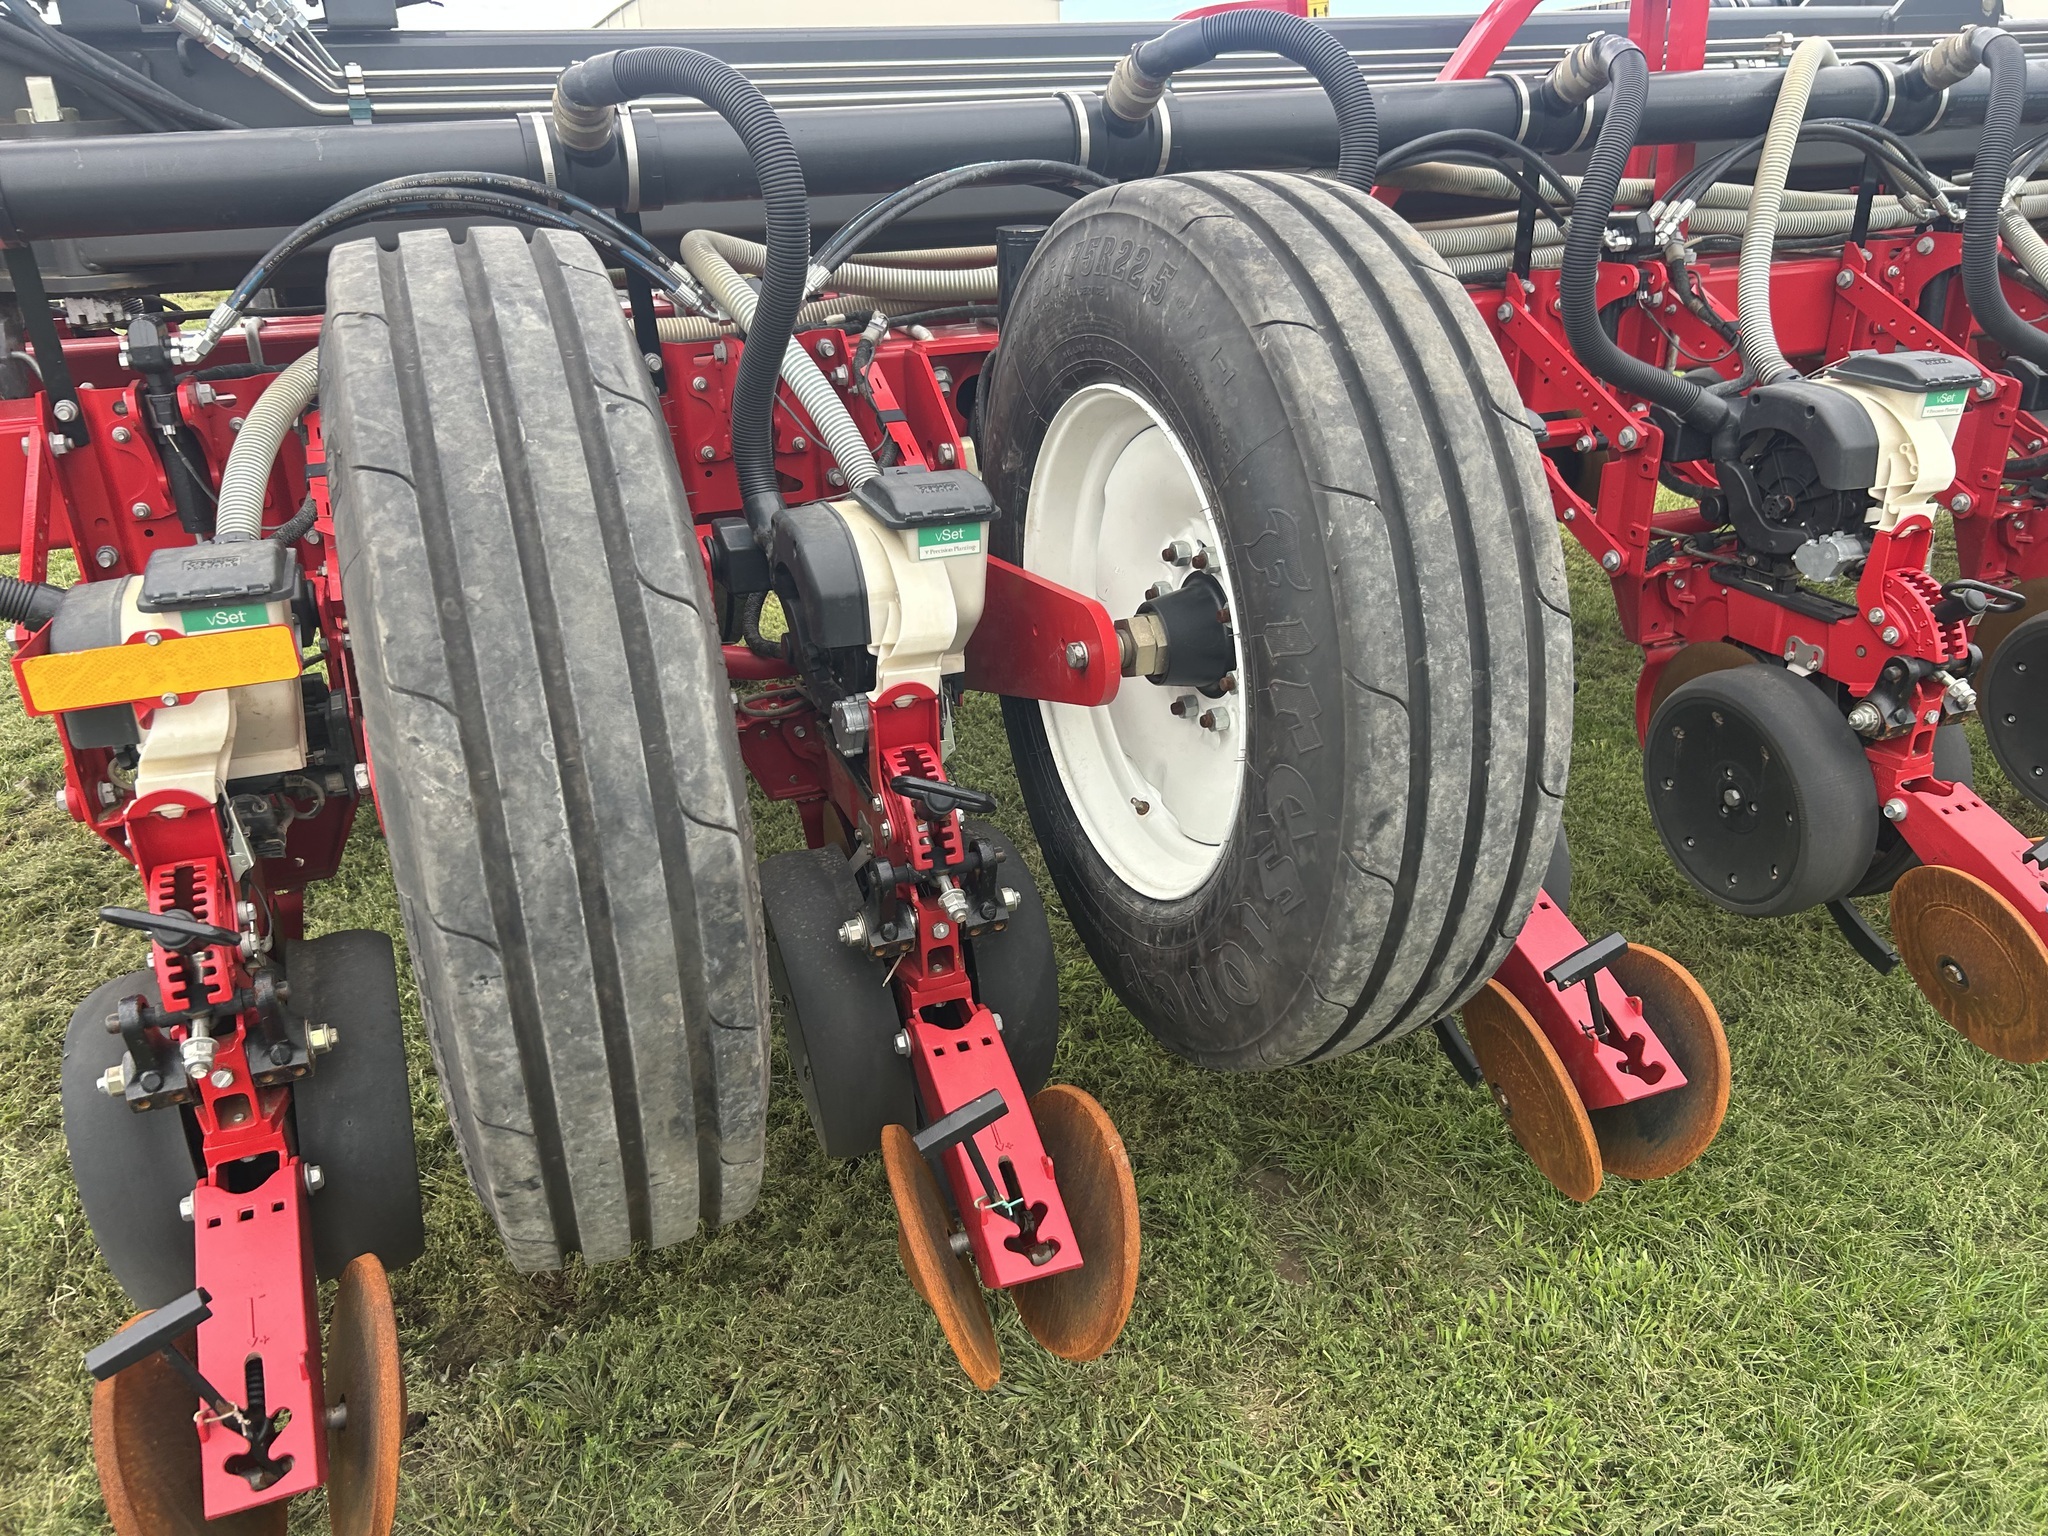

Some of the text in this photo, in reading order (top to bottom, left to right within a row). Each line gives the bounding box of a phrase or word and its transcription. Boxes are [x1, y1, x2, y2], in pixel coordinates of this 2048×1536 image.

[1936, 393, 1956, 403] vSet
[935, 528, 964, 542] vSet
[929, 547, 954, 555] Precision
[206, 610, 246, 626] vSet
